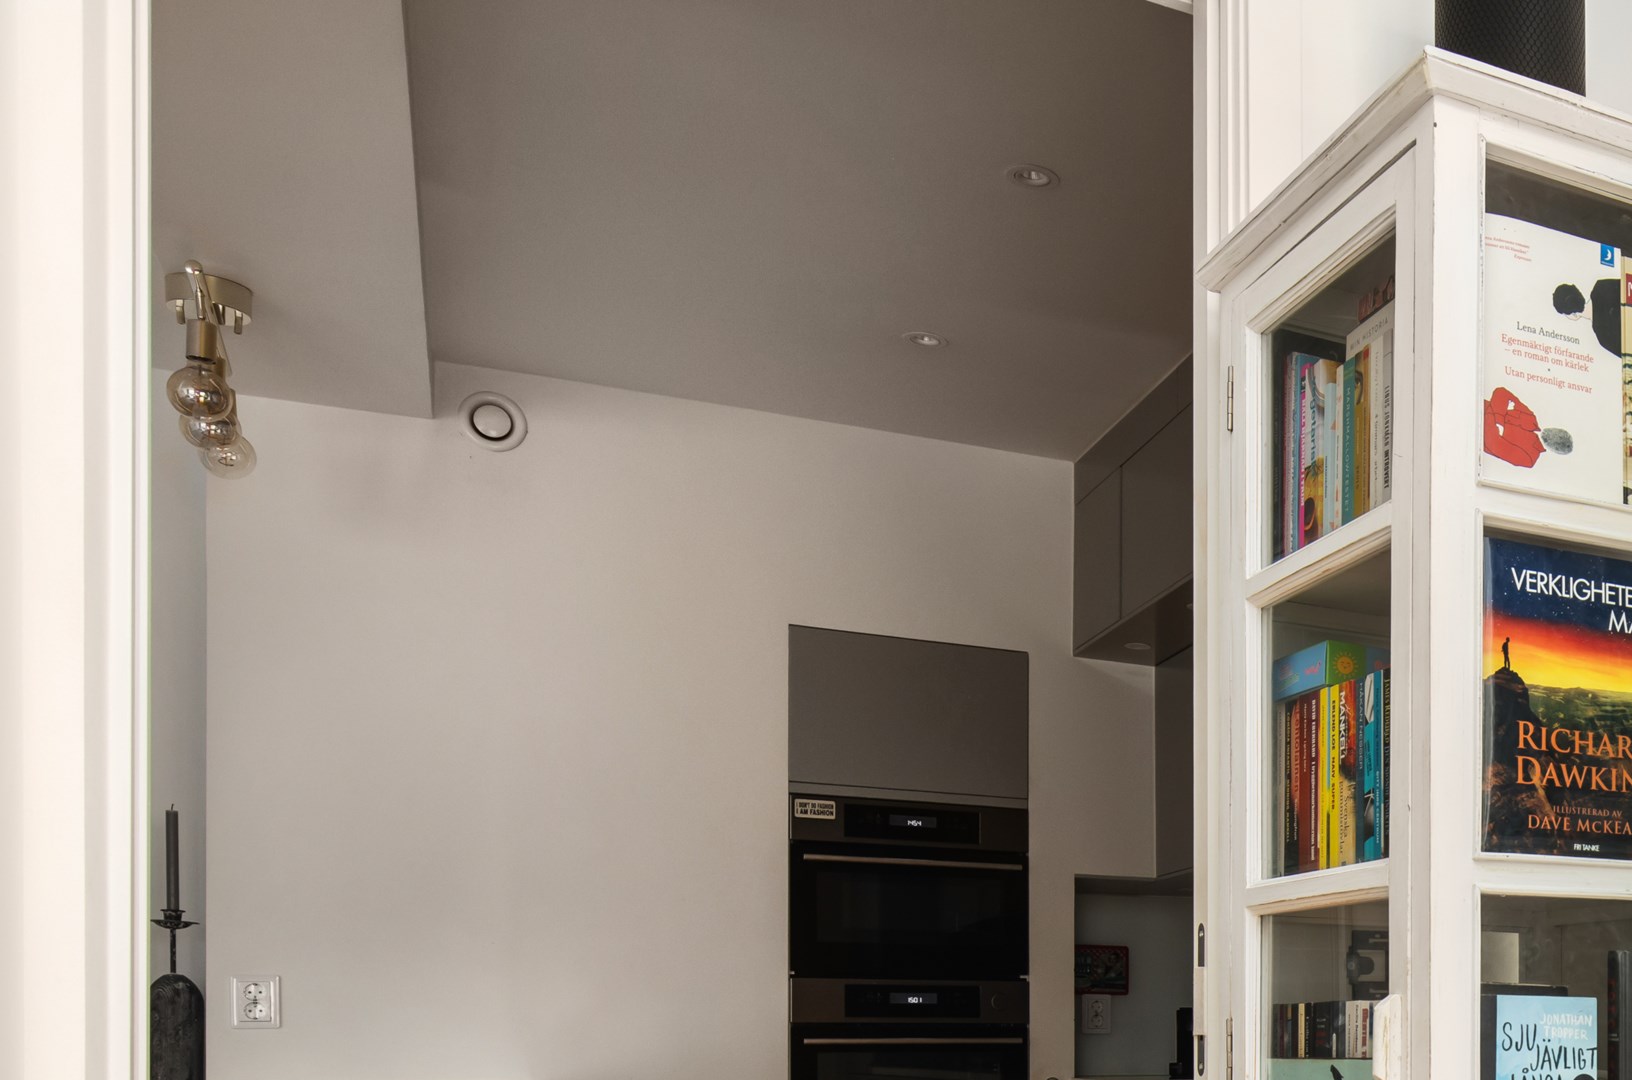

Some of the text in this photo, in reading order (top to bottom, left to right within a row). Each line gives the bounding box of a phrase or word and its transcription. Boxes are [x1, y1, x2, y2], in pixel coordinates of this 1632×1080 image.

[1517, 321, 1581, 345] Lena Andersson
[1501, 333, 1595, 364] Egenmäktigt förfarande
[1512, 349, 1590, 373] en roman om kärlek
[1504, 366, 1593, 394] Utan personligt ansvar
[810, 808, 834, 817] FASHION
[1553, 805, 1623, 818] ILLUSTRERAD AV
[1528, 814, 1571, 832] DAVE
[1573, 843, 1600, 852] FRI TANKE
[1539, 1013, 1593, 1027] JONATHAN
[1501, 1021, 1537, 1052] SJU
[1543, 1025, 1589, 1040] TROPPER
[1530, 1038, 1597, 1072] JÄVLIGT
